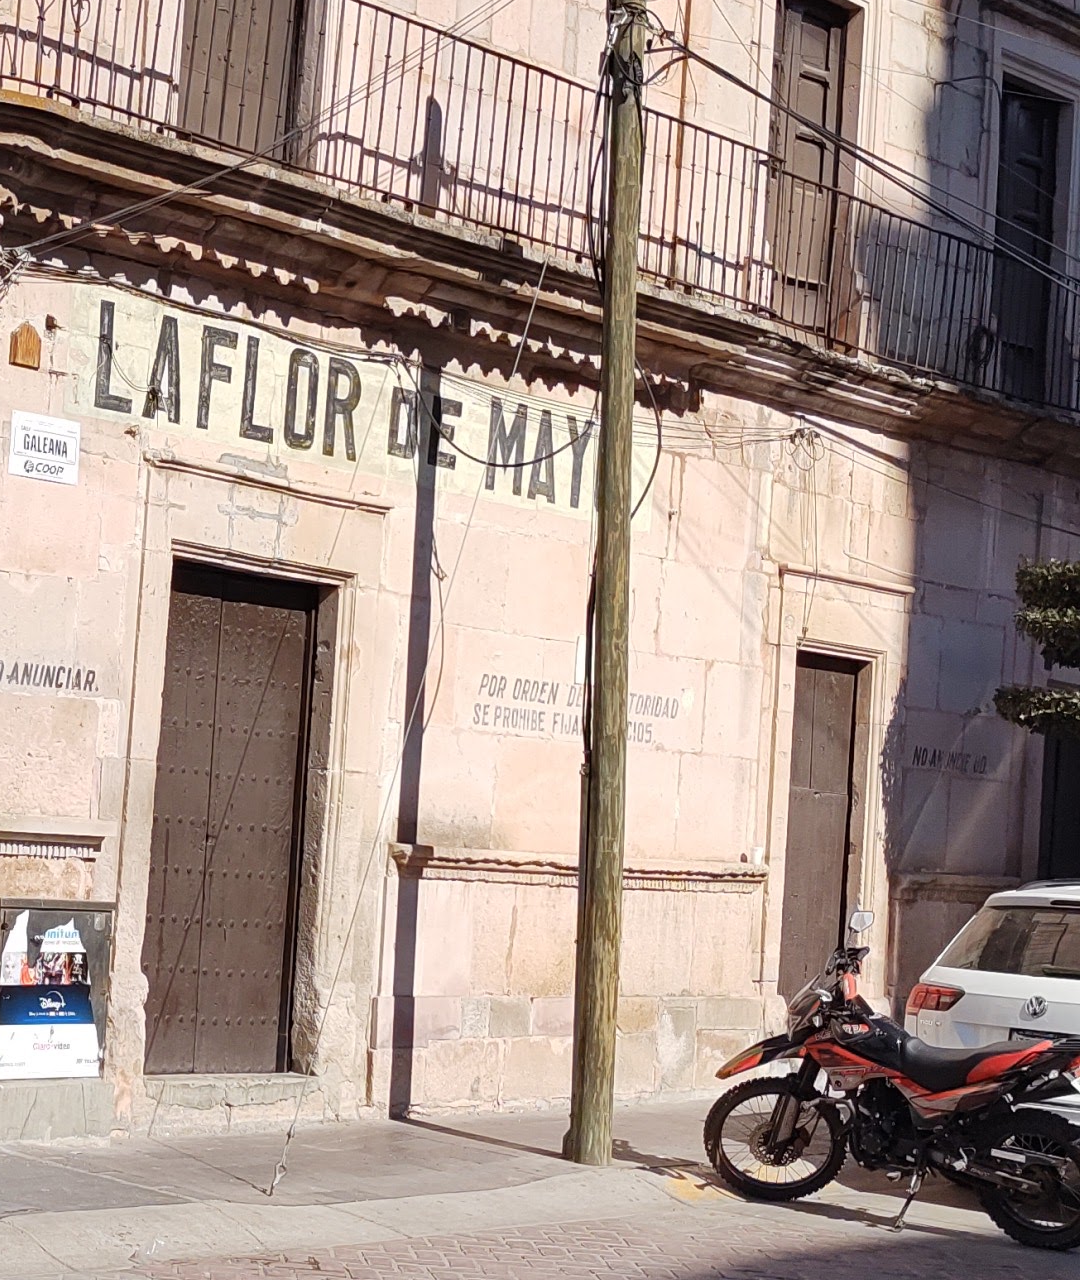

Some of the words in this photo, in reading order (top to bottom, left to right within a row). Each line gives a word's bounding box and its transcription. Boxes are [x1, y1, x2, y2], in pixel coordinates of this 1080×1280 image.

[94, 299, 181, 426] LA
[196, 323, 363, 463] FLOR
[386, 383, 464, 471] DE
[484, 395, 594, 510] MAY
[23, 433, 68, 460] GALEANA
[35, 462, 65, 476] COOP
[6, 661, 99, 693] ANUNCIAR.
[477, 672, 508, 699] POR
[512, 677, 560, 706] ORDEN
[627, 692, 680, 720] TORIDAD
[473, 702, 490, 726] SE
[493, 705, 546, 732] PROHIBE
[552, 711, 583, 736] FIJA
[626, 720, 657, 745] CIOS.
[911, 745, 928, 767] NO
